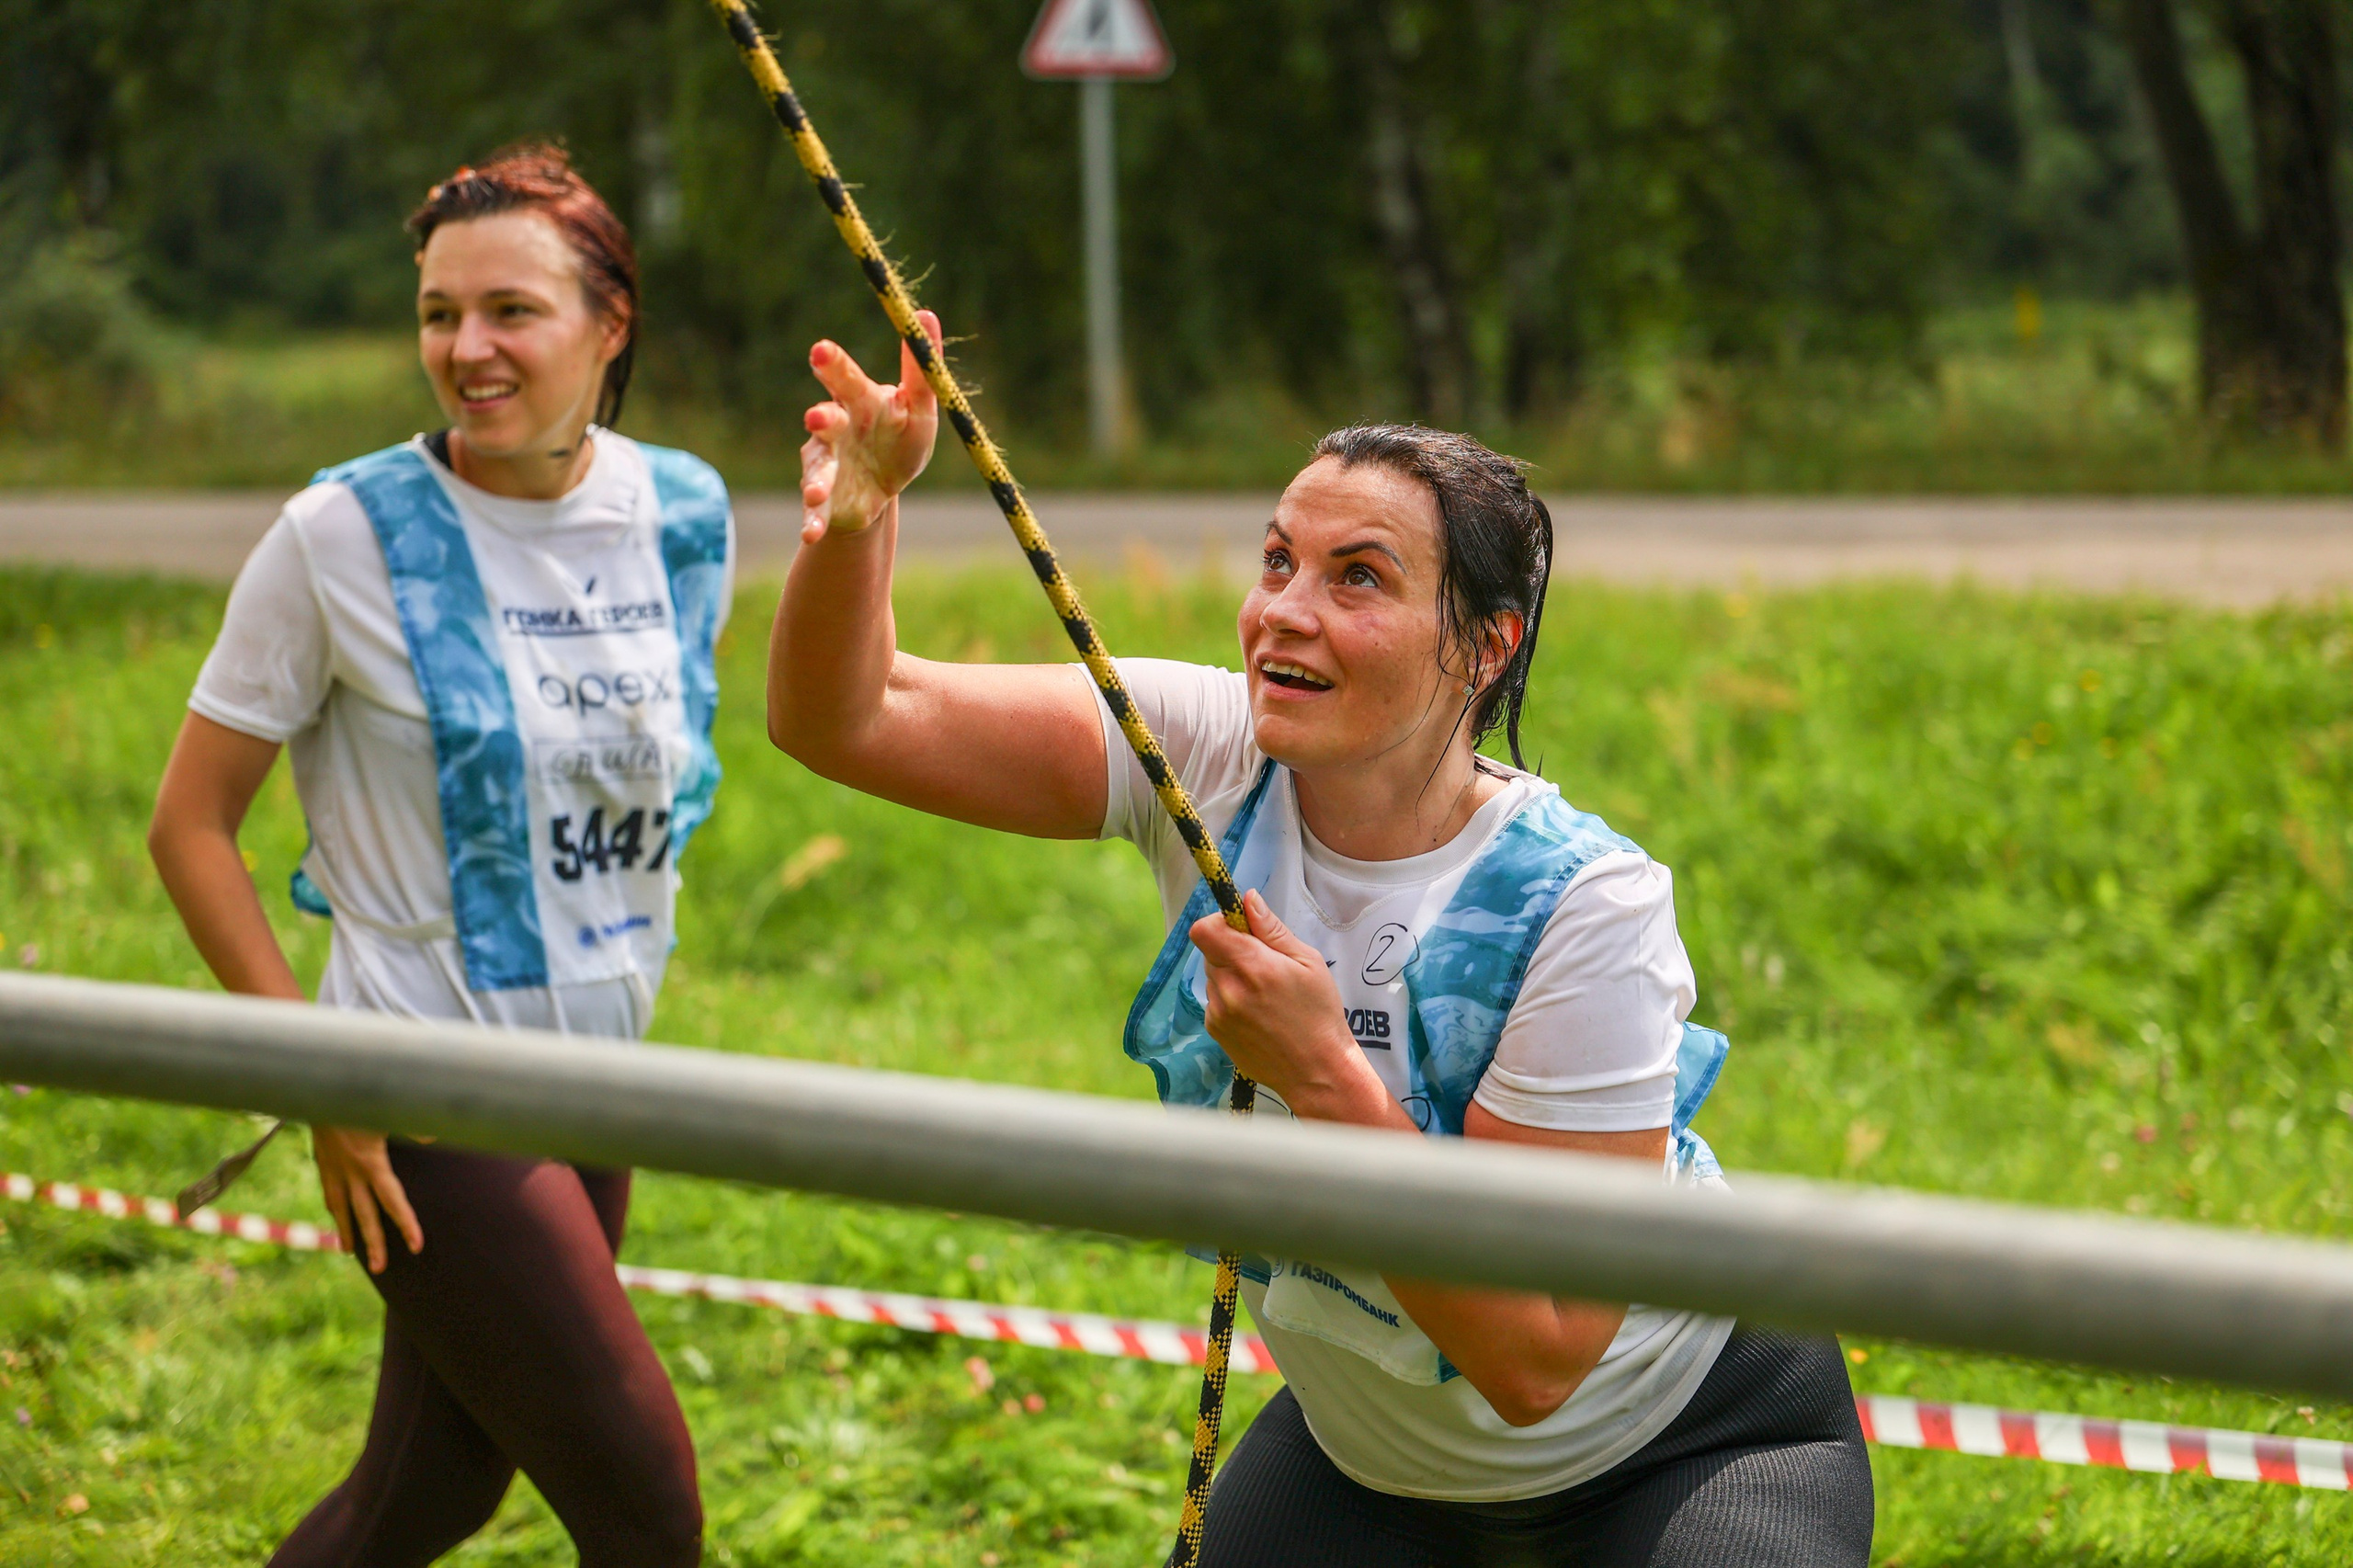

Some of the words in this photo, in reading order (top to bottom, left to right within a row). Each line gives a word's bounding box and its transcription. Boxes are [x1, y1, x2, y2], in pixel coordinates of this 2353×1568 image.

[539, 668, 672, 717] apex
[551, 806, 671, 883] 5447
[1366, 935, 1394, 972] 2
[1290, 1259, 1401, 1328] ГАЗПРОМБАНК
